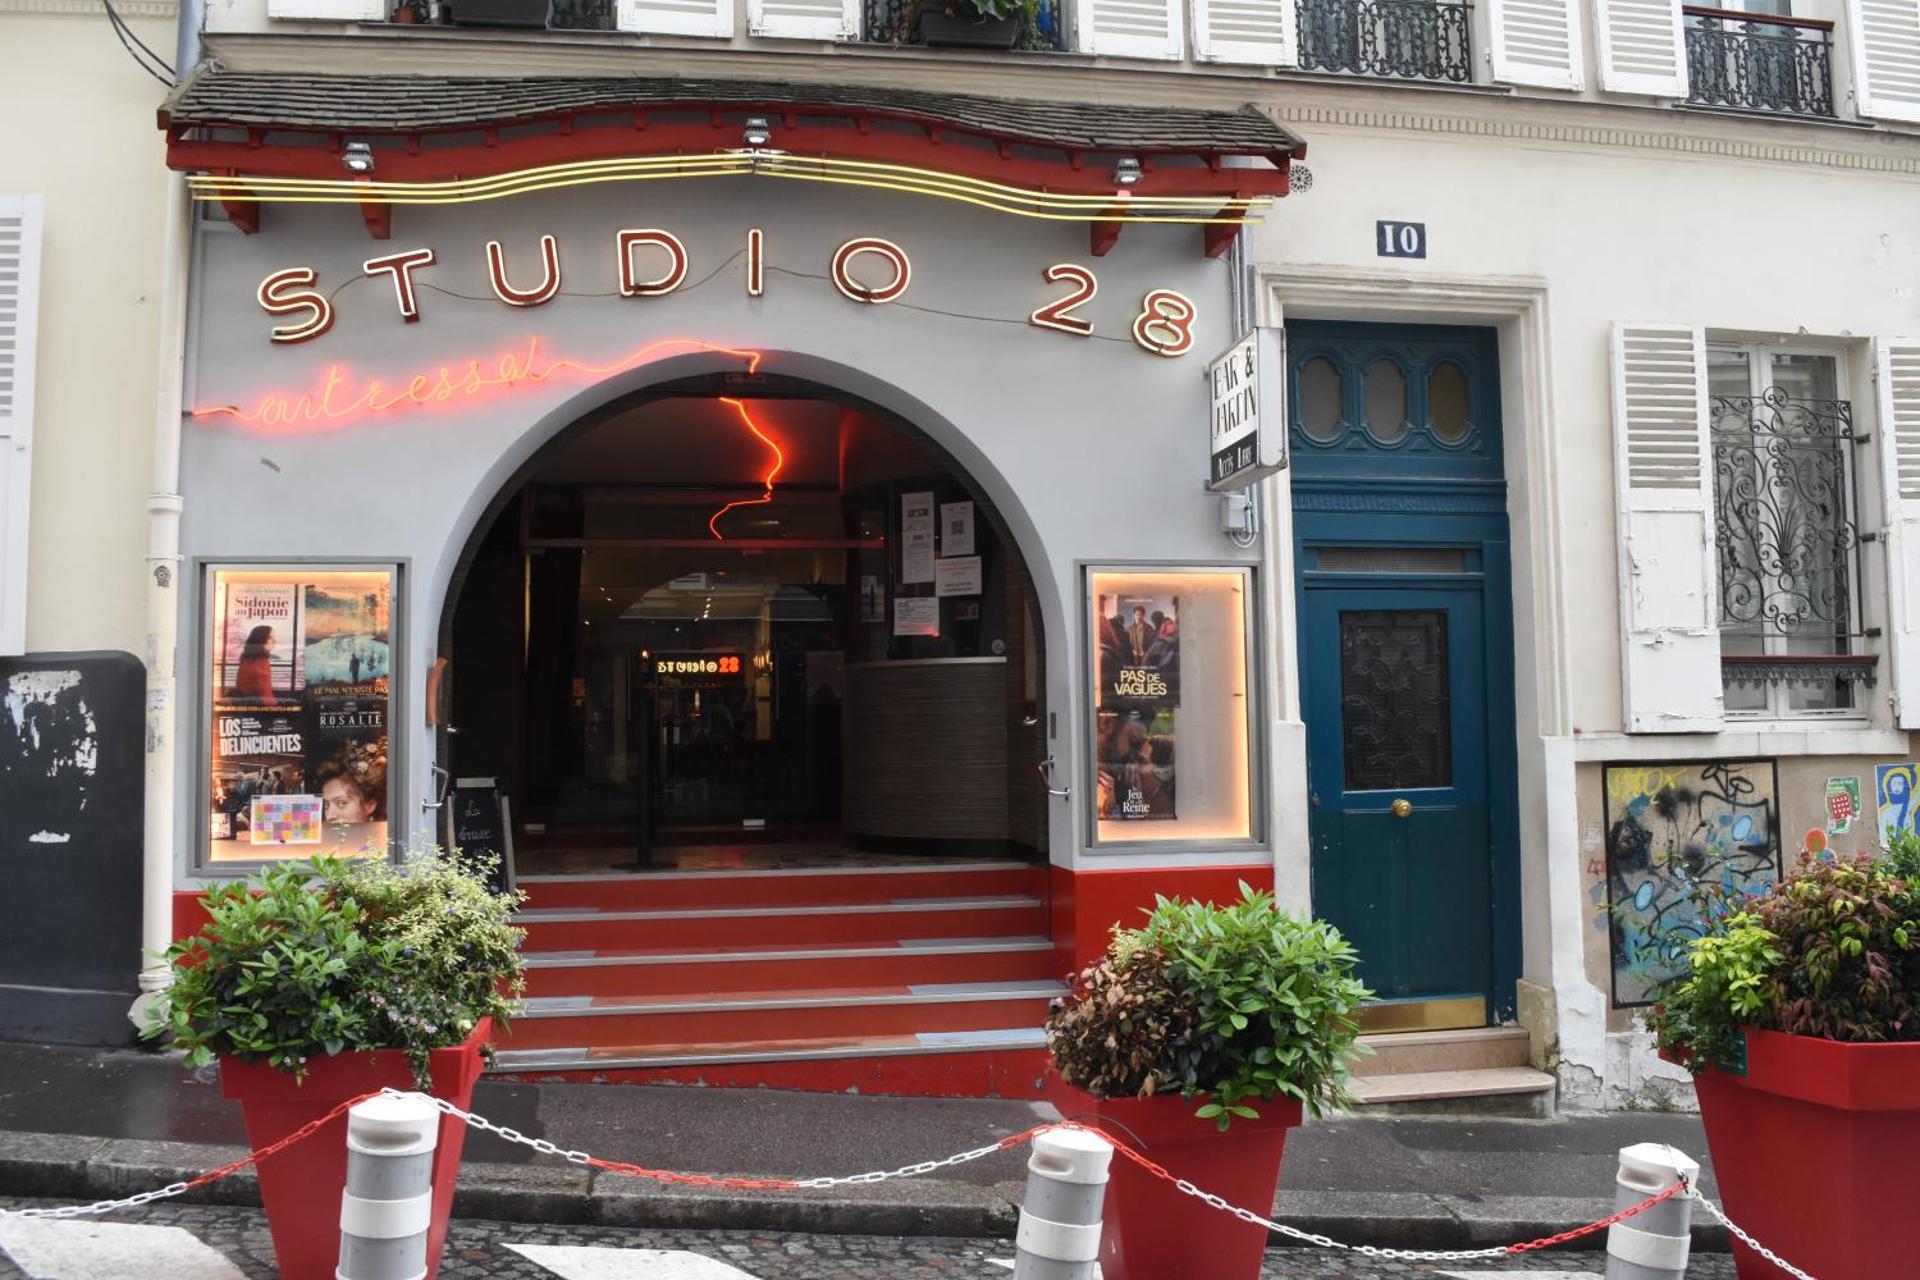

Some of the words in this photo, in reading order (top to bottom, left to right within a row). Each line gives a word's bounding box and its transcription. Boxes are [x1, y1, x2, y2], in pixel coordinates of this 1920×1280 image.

[1383, 224, 1419, 254] 10
[257, 227, 912, 345] STUDIO
[1028, 262, 1200, 358] 28
[1213, 354, 1239, 401] BAR
[1244, 345, 1254, 379] &
[1212, 384, 1257, 440] JARDIN
[234, 594, 289, 608] Sidonie
[719, 656, 740, 673] 28
[1120, 669, 1146, 683] PAS
[1146, 673, 1161, 684] DE
[1114, 682, 1168, 696] VAGUES
[219, 717, 242, 737] LOS
[319, 714, 383, 725] ROSALIE
[219, 734, 302, 756] DELINCUENTES
[1127, 789, 1143, 801] Jeu
[1122, 801, 1151, 813] Reine
